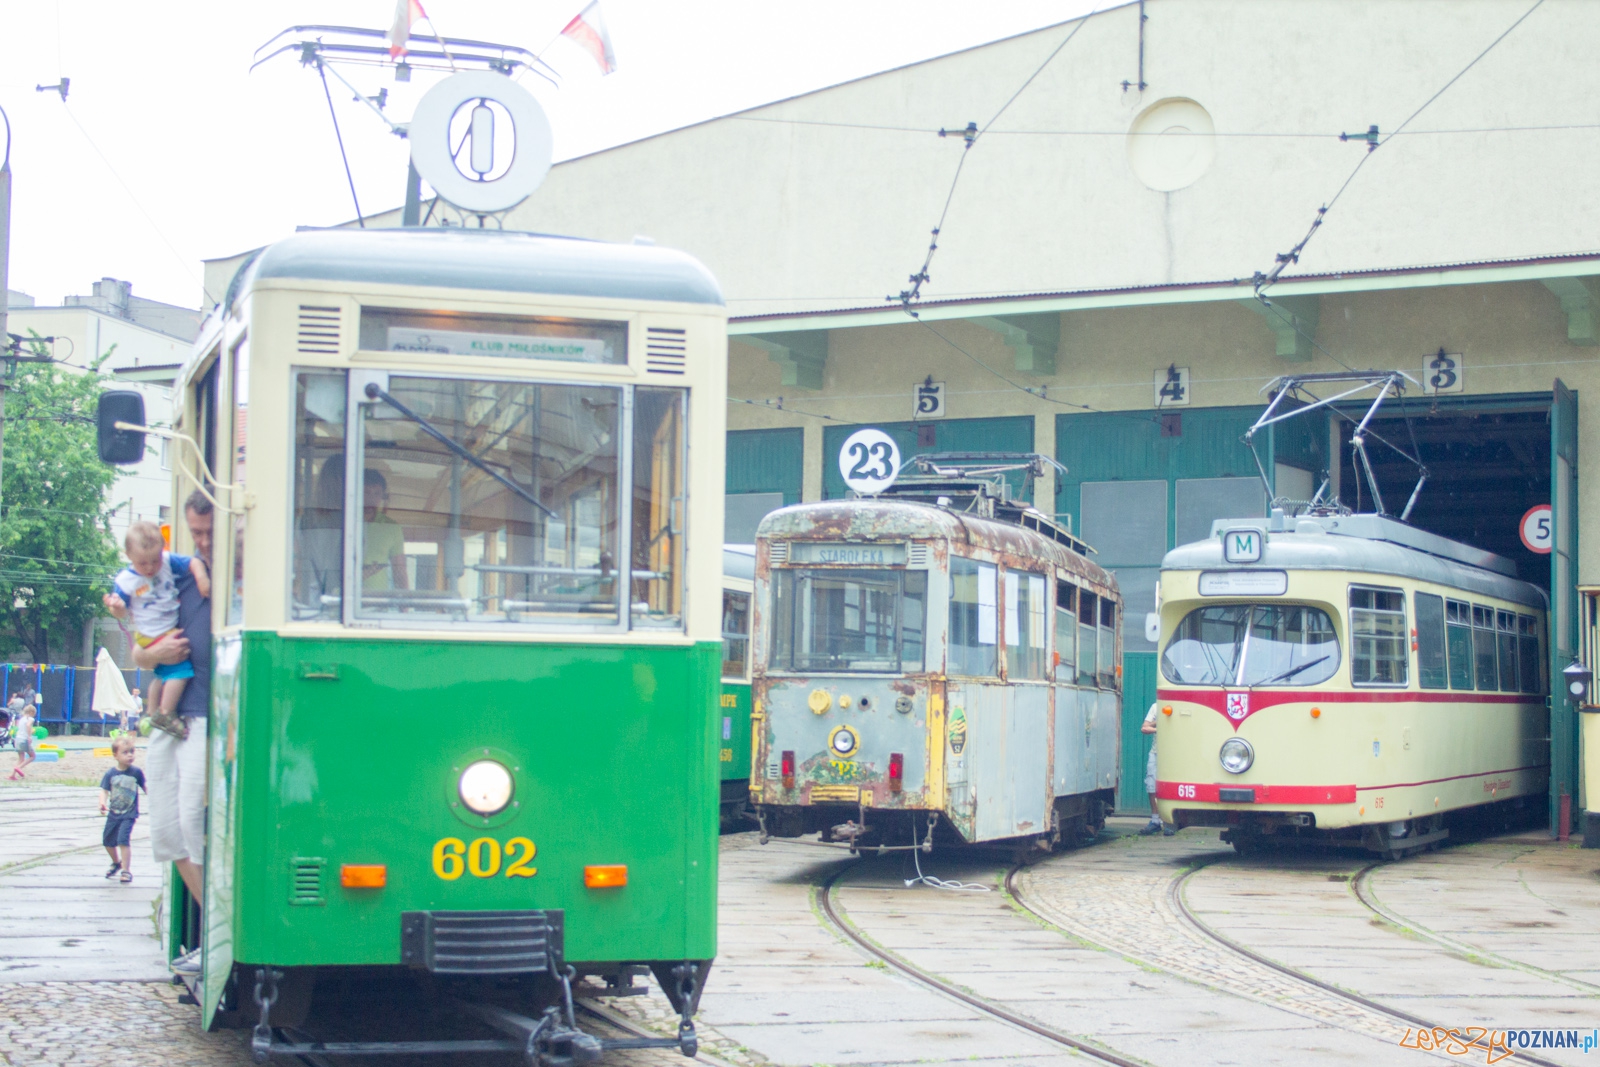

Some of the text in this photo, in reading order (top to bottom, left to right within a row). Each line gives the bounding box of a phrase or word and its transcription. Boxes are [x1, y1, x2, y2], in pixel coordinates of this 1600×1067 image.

[471, 340, 504, 351] KLUB
[1160, 371, 1185, 401] 4
[1430, 358, 1456, 389] 3
[918, 386, 940, 413] 5
[848, 441, 894, 481] 23
[1536, 518, 1550, 540] 5
[1235, 535, 1252, 554] M
[1178, 784, 1195, 798] 615
[432, 836, 538, 880] 602
